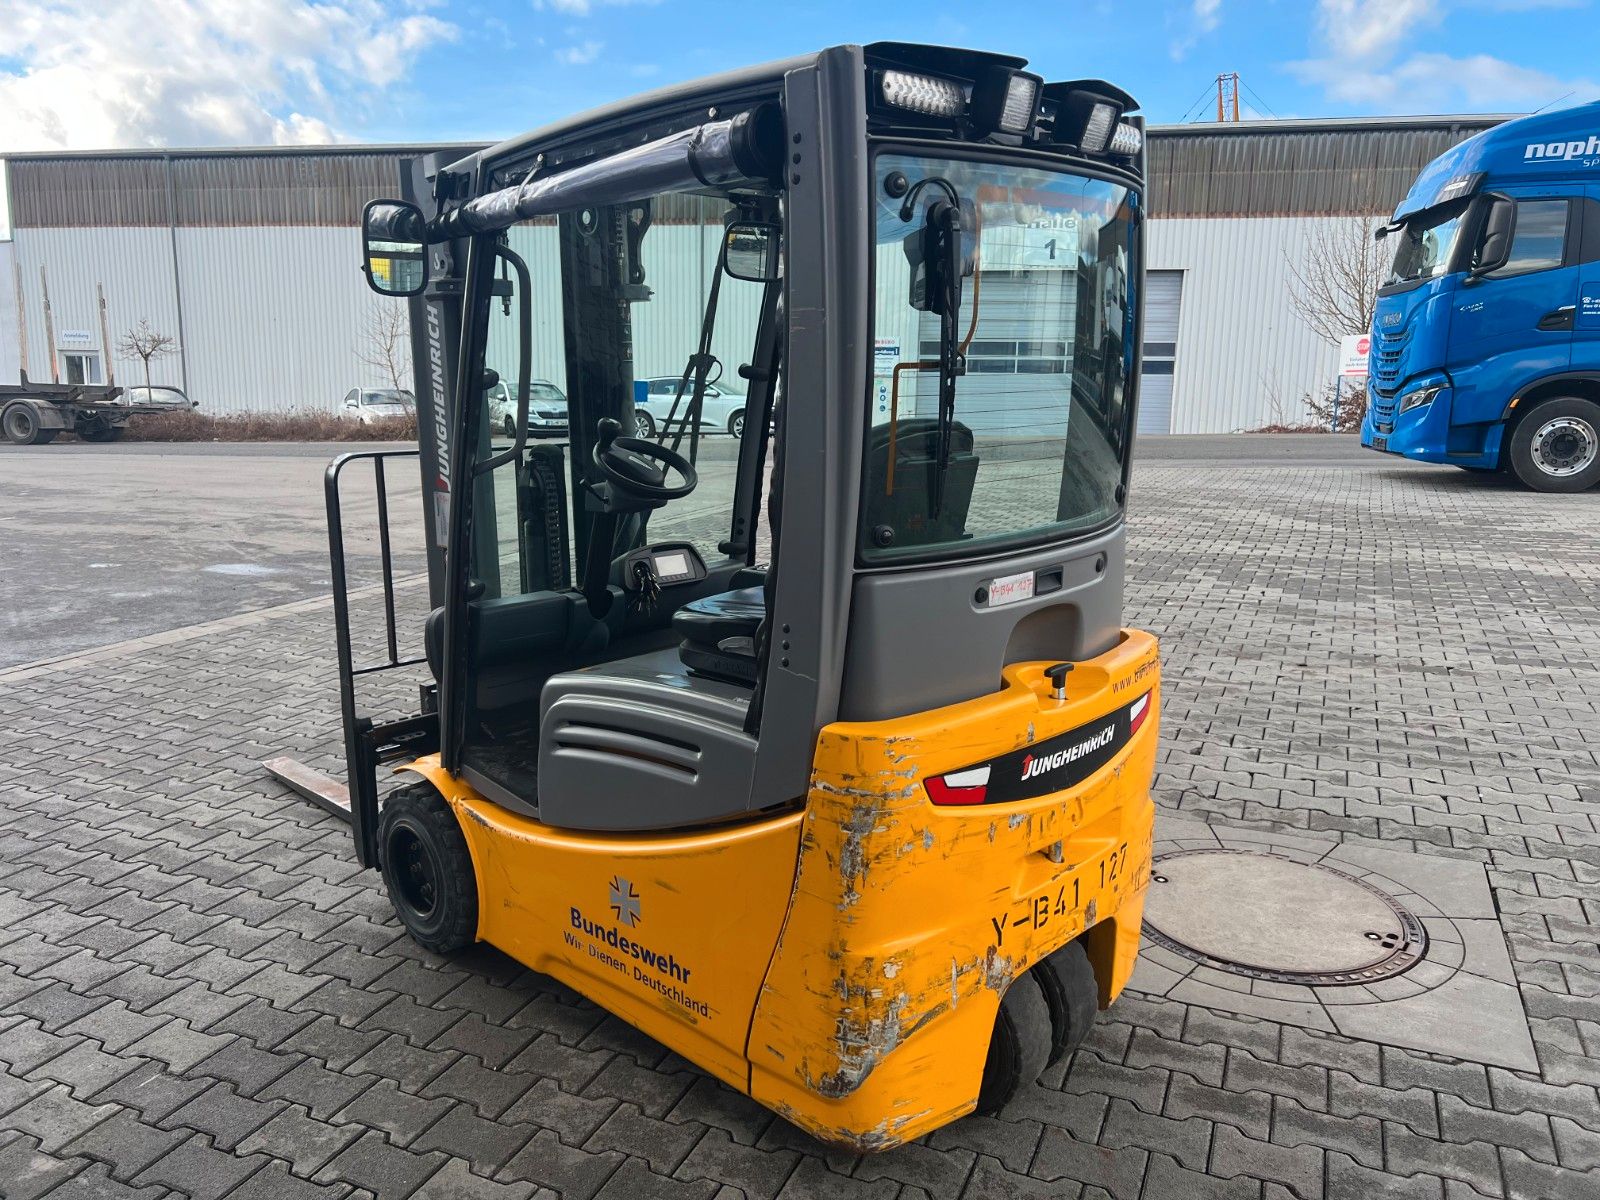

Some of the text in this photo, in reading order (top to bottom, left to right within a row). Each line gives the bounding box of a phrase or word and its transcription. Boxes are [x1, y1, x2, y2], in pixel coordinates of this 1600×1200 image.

[1044, 238, 1057, 260] 1
[427, 305, 451, 491] JUNGHEINRICH
[1021, 724, 1115, 781] JUNGHEINRICH
[991, 876, 1080, 948] Y-B41
[1099, 842, 1129, 889] 127
[570, 906, 691, 985] Bundeswehr
[588, 943, 631, 977] Dienen.
[633, 966, 713, 1020] Deutschland.
